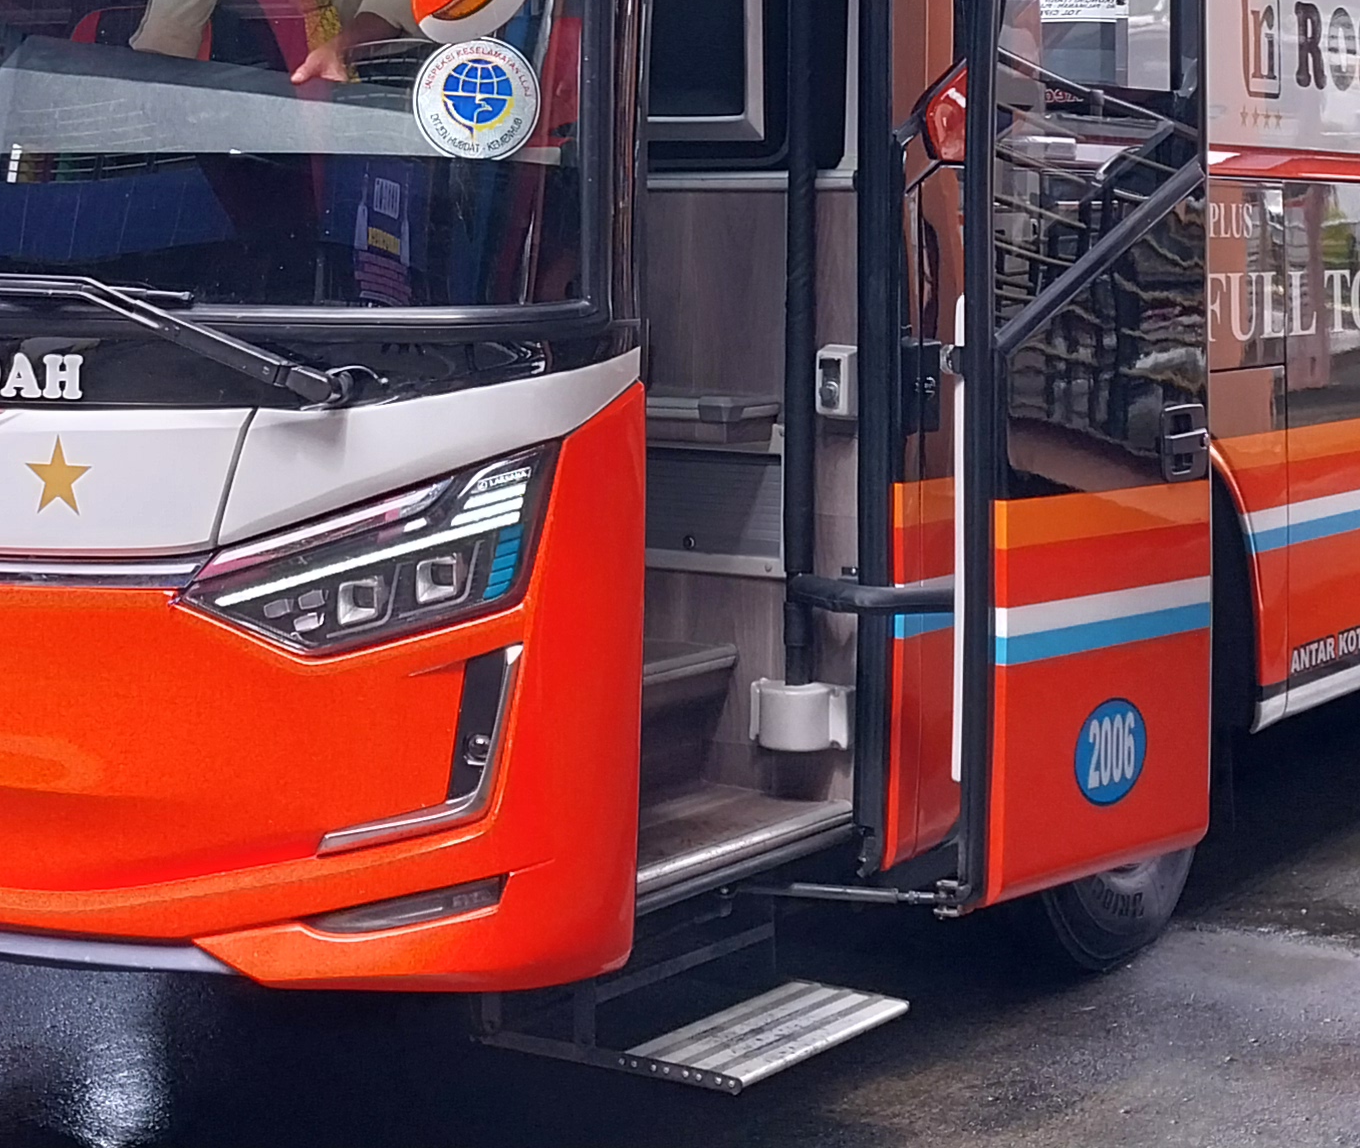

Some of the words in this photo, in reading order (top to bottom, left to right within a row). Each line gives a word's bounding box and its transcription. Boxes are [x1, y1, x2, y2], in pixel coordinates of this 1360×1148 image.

[1209, 201, 1252, 239] PLUS
[1208, 271, 1317, 341] FULL
[1291, 637, 1335, 674] ANTAR
[1088, 711, 1135, 789] 2006
